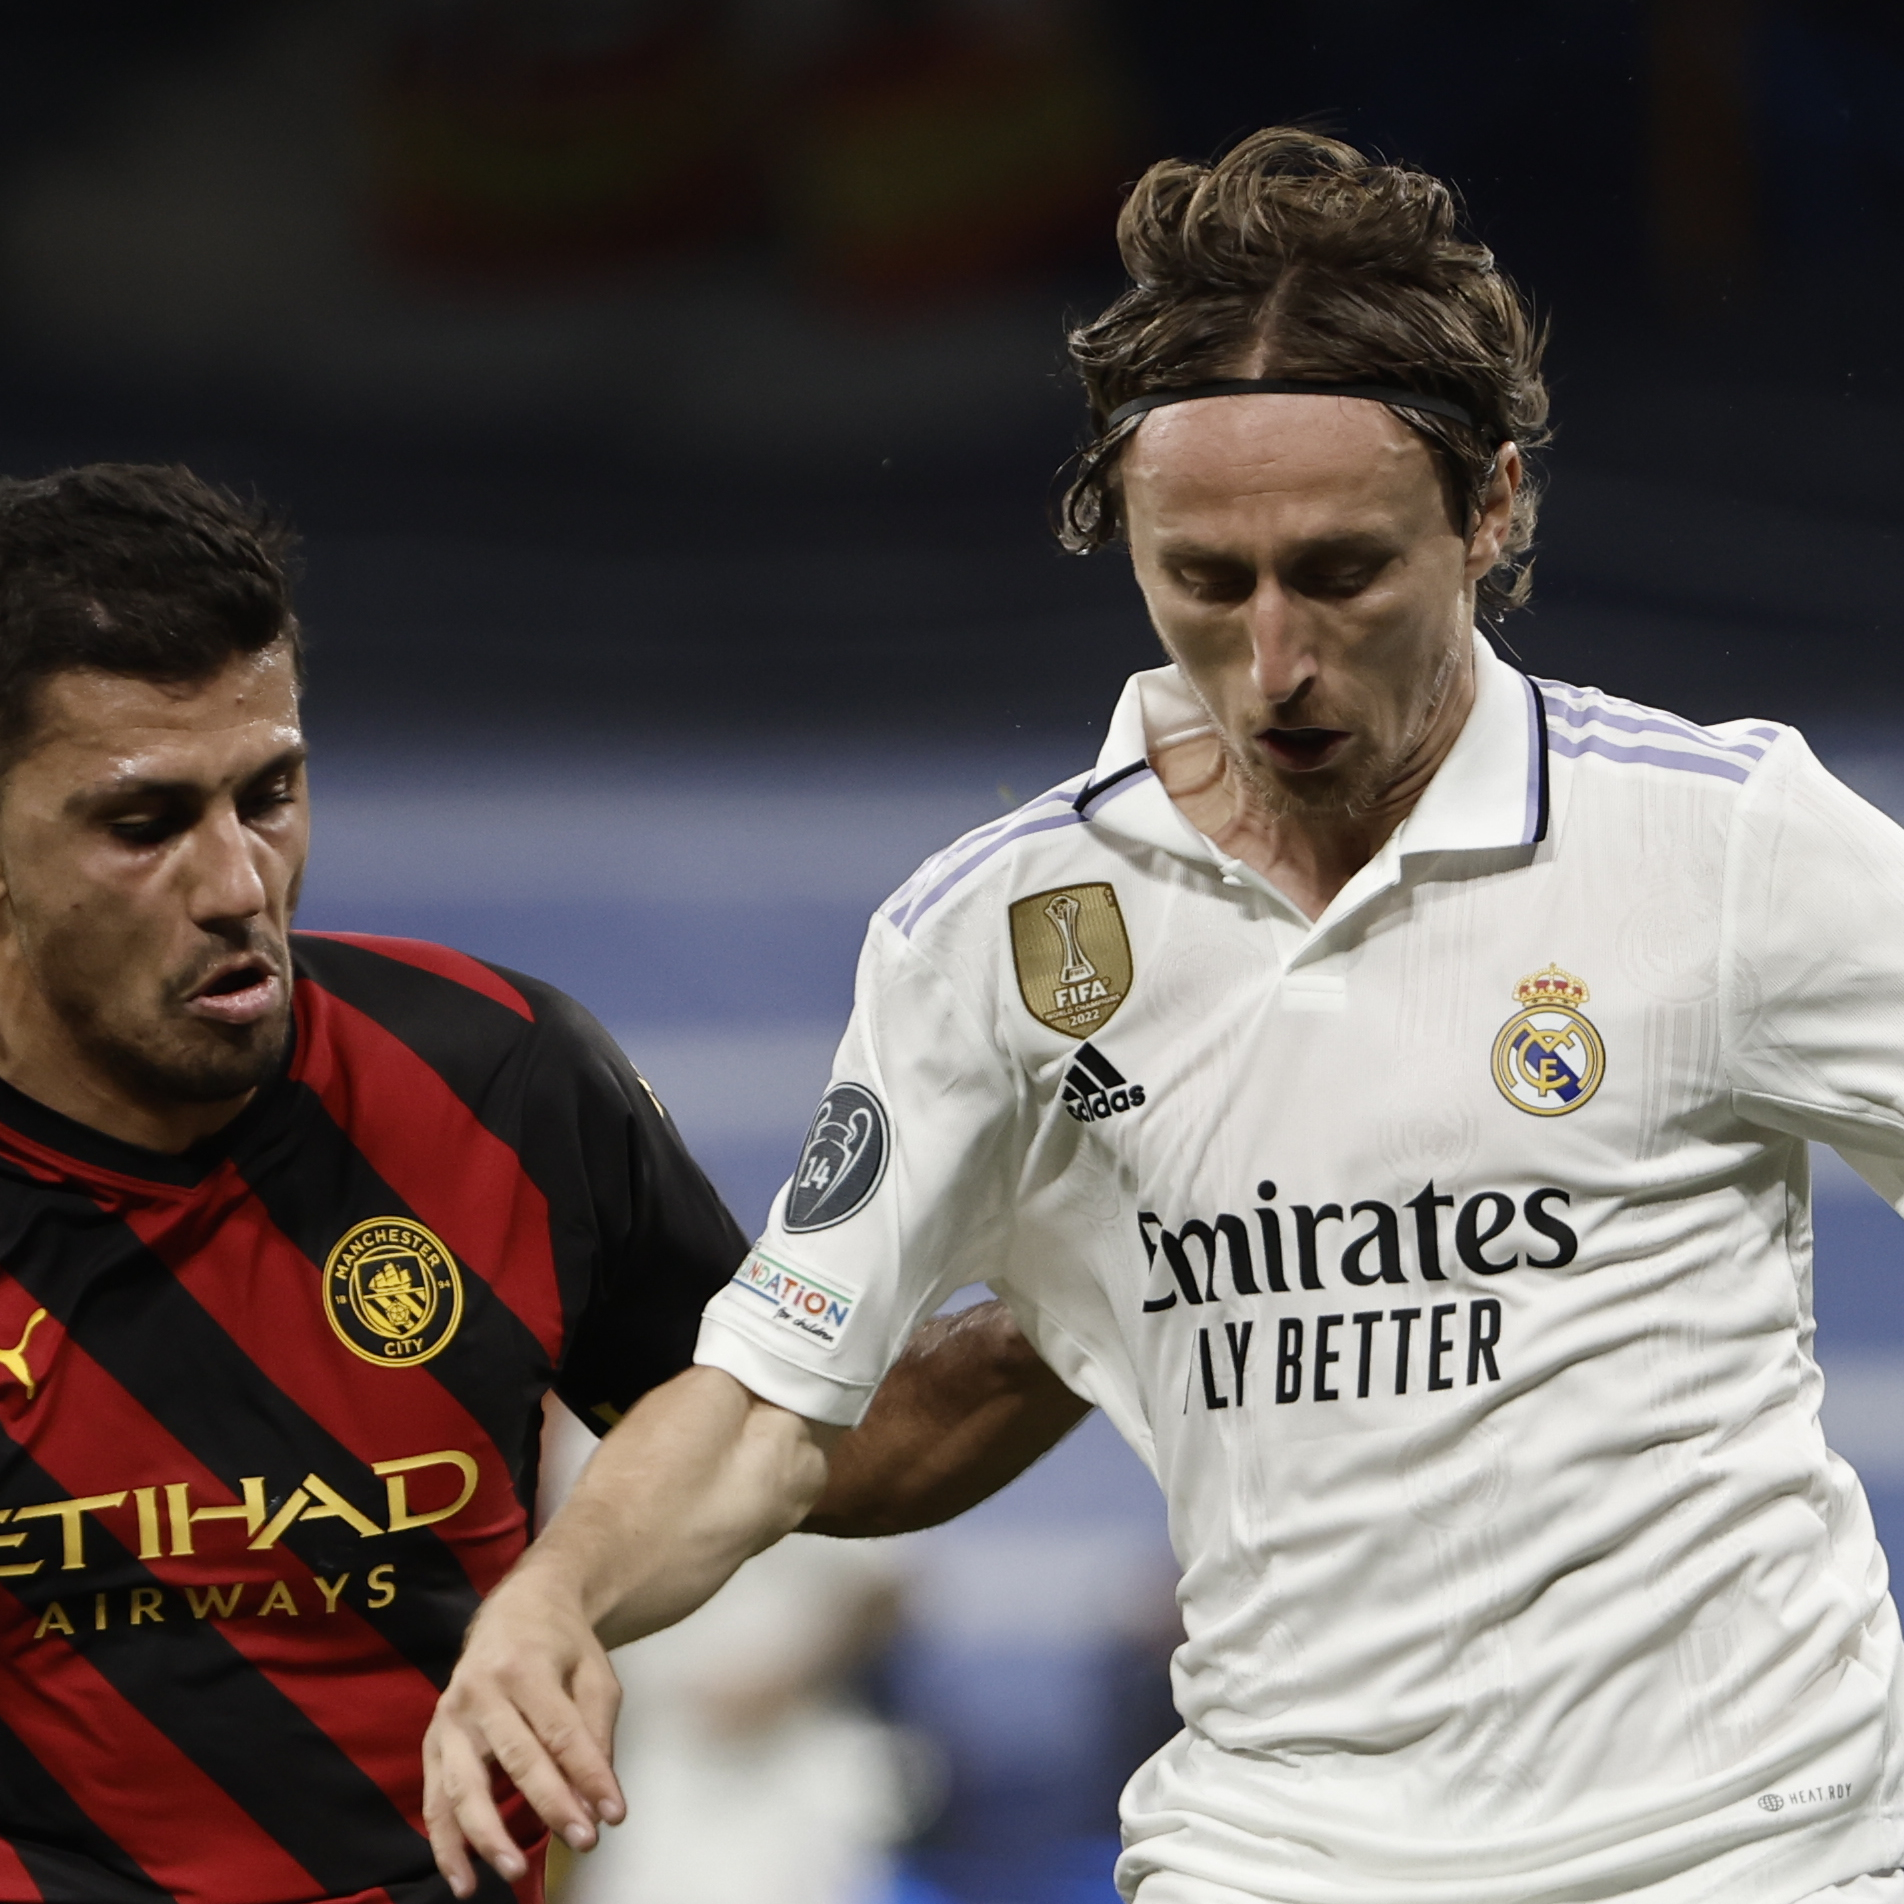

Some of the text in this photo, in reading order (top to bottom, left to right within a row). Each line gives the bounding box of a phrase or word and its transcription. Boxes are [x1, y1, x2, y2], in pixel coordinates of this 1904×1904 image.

[1045, 993, 1121, 1020] WORLD CHAMPIONS
[1055, 980, 1108, 1009] FIFA
[1069, 1009, 1100, 1026] 2022
[799, 1155, 831, 1190] 14
[335, 1228, 441, 1280] MANCHESTER
[1137, 1178, 1579, 1312] Emirates
[383, 1338, 424, 1356] CITY
[1194, 1298, 1501, 1411] LY BETTER
[33, 1563, 396, 1640] AIRWAYS
